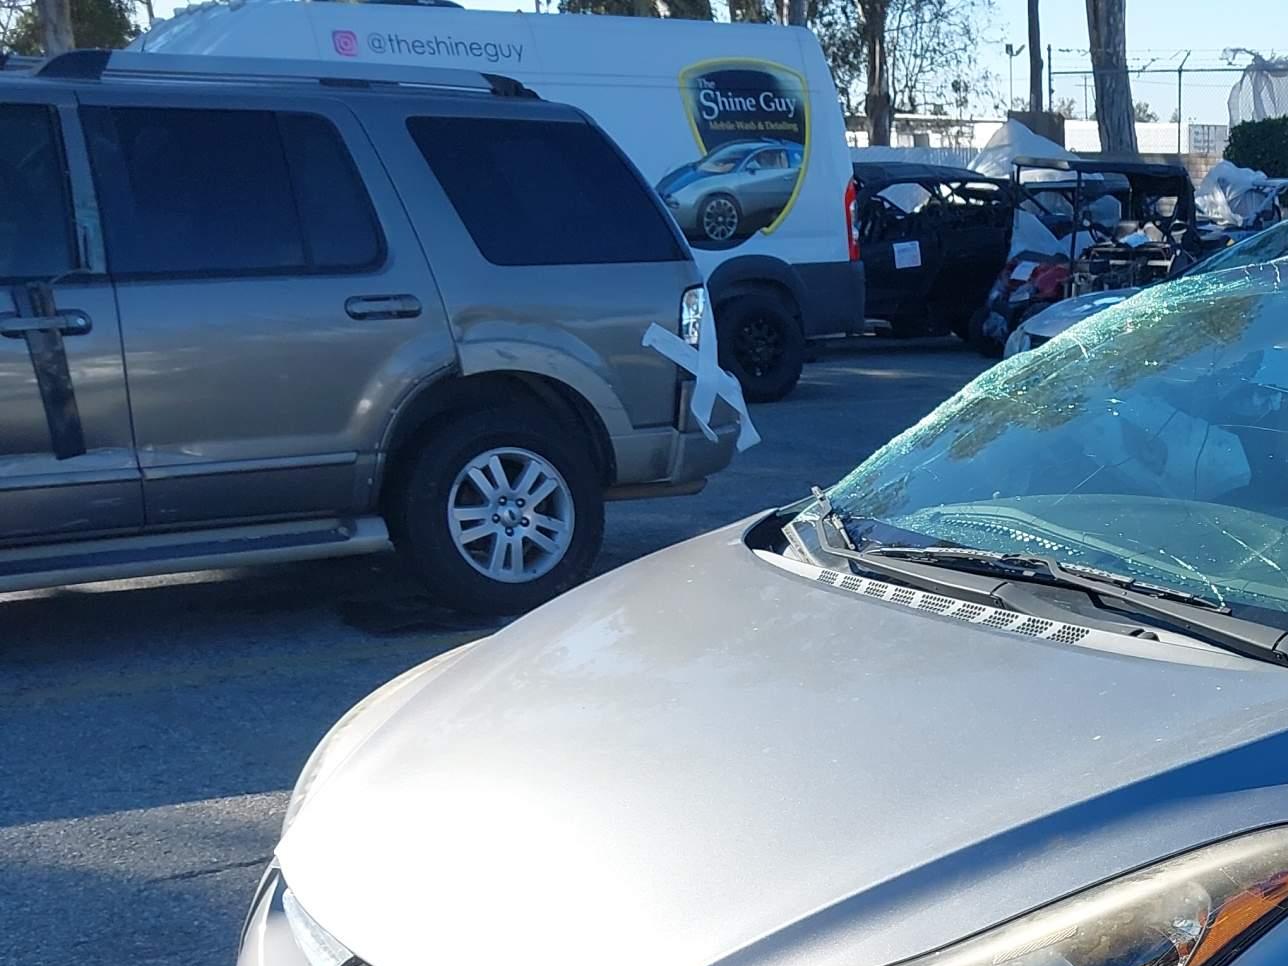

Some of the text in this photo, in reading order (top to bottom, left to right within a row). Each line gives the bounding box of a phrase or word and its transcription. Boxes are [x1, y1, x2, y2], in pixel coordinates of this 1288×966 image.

[367, 32, 524, 63] @theshineguy
[697, 78, 716, 89] The
[700, 89, 796, 120] Shine Guy
[736, 121, 756, 131] Wash
[757, 121, 765, 131] &
[766, 121, 799, 132] Detailing
